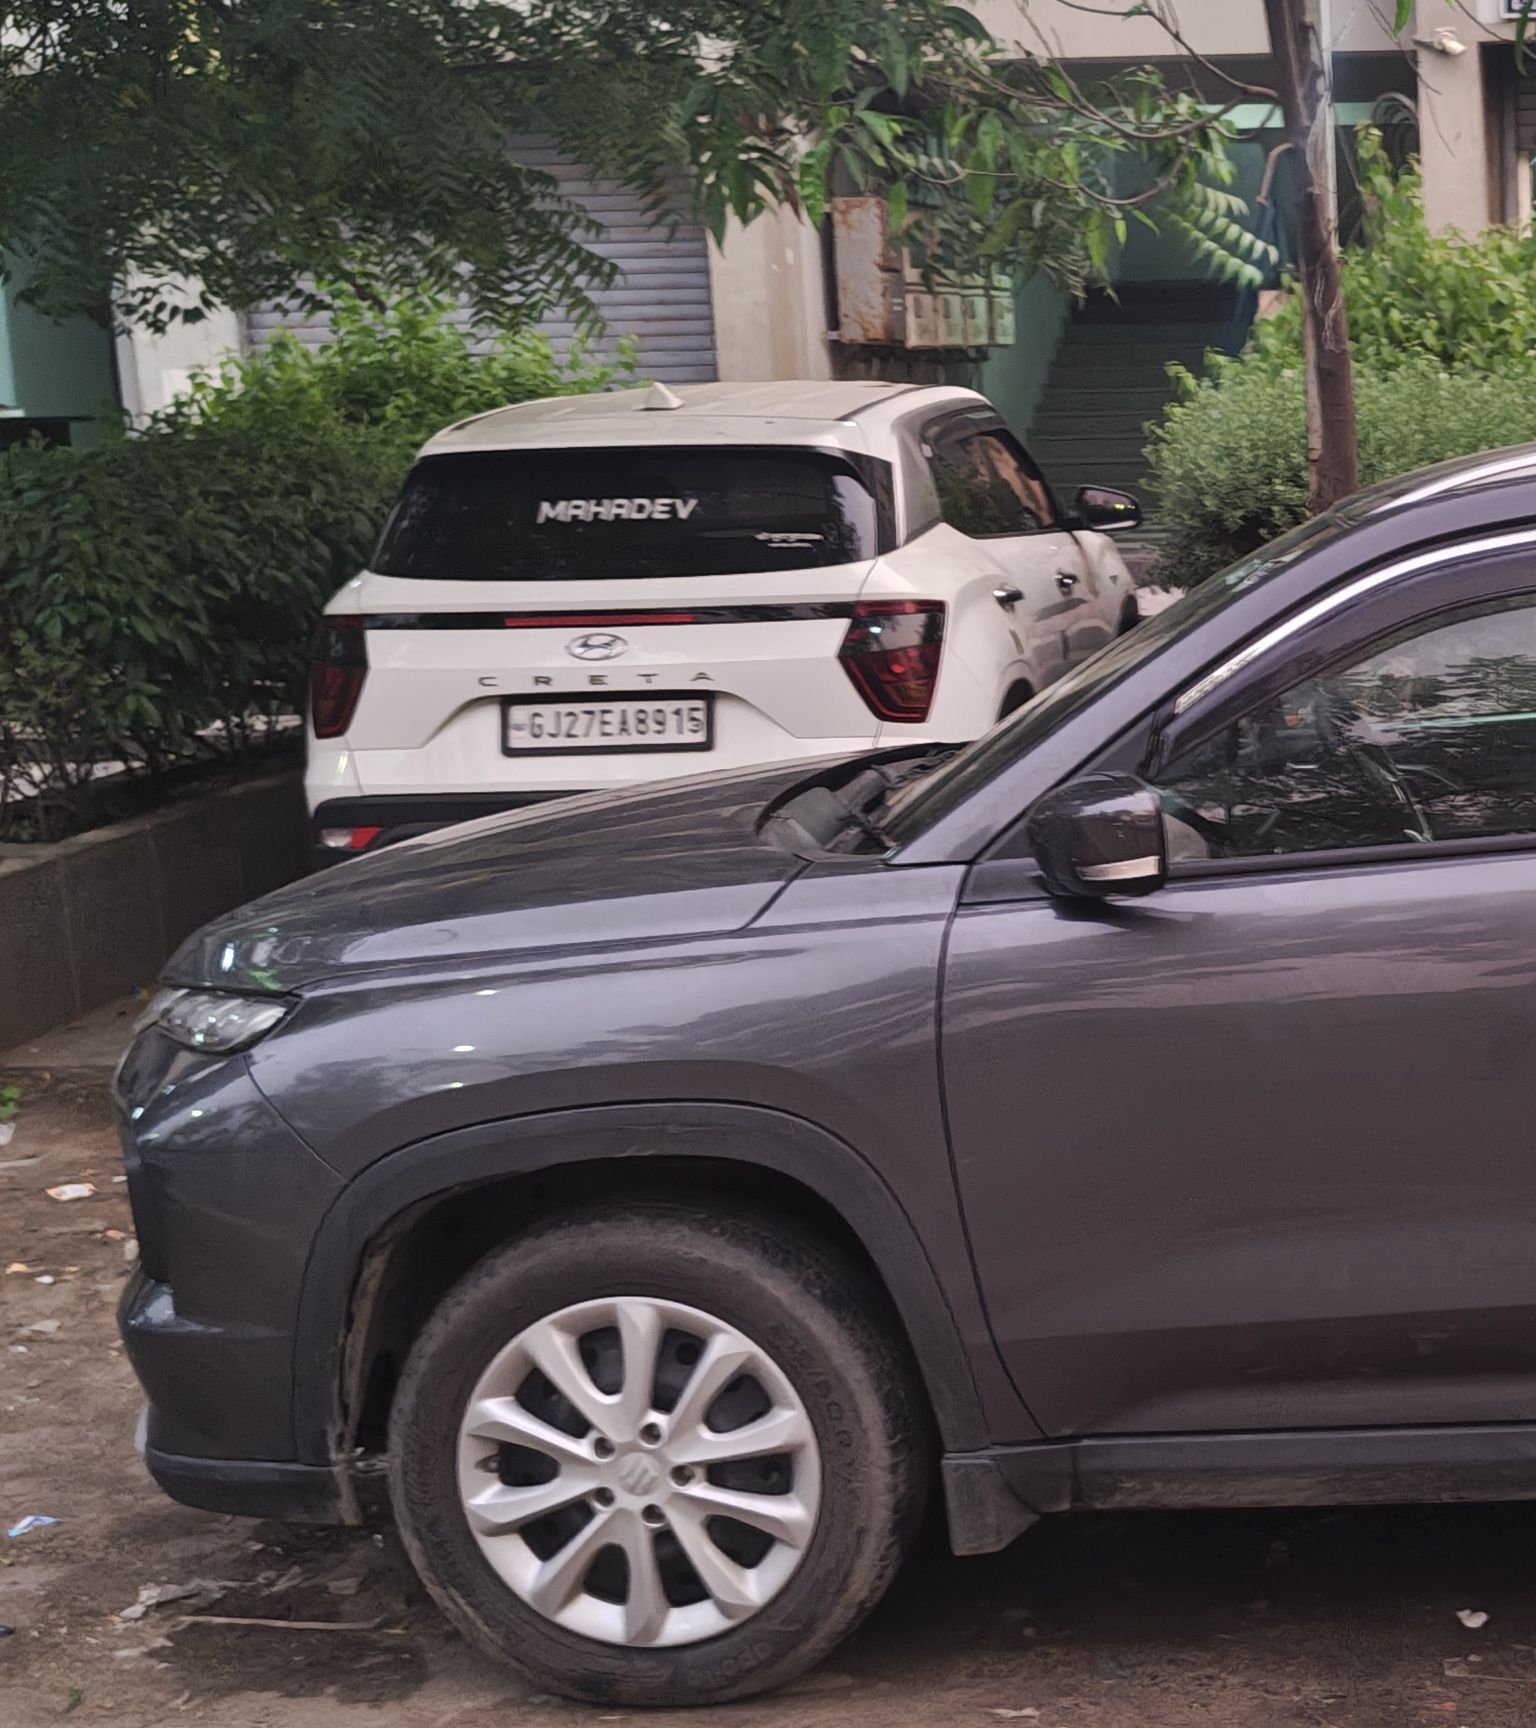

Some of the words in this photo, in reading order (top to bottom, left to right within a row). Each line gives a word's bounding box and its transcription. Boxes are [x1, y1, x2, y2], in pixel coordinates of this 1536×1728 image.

[536, 498, 698, 524] MAHADEV
[478, 671, 716, 687] CRETA
[528, 707, 705, 739] GJ27EA8915
